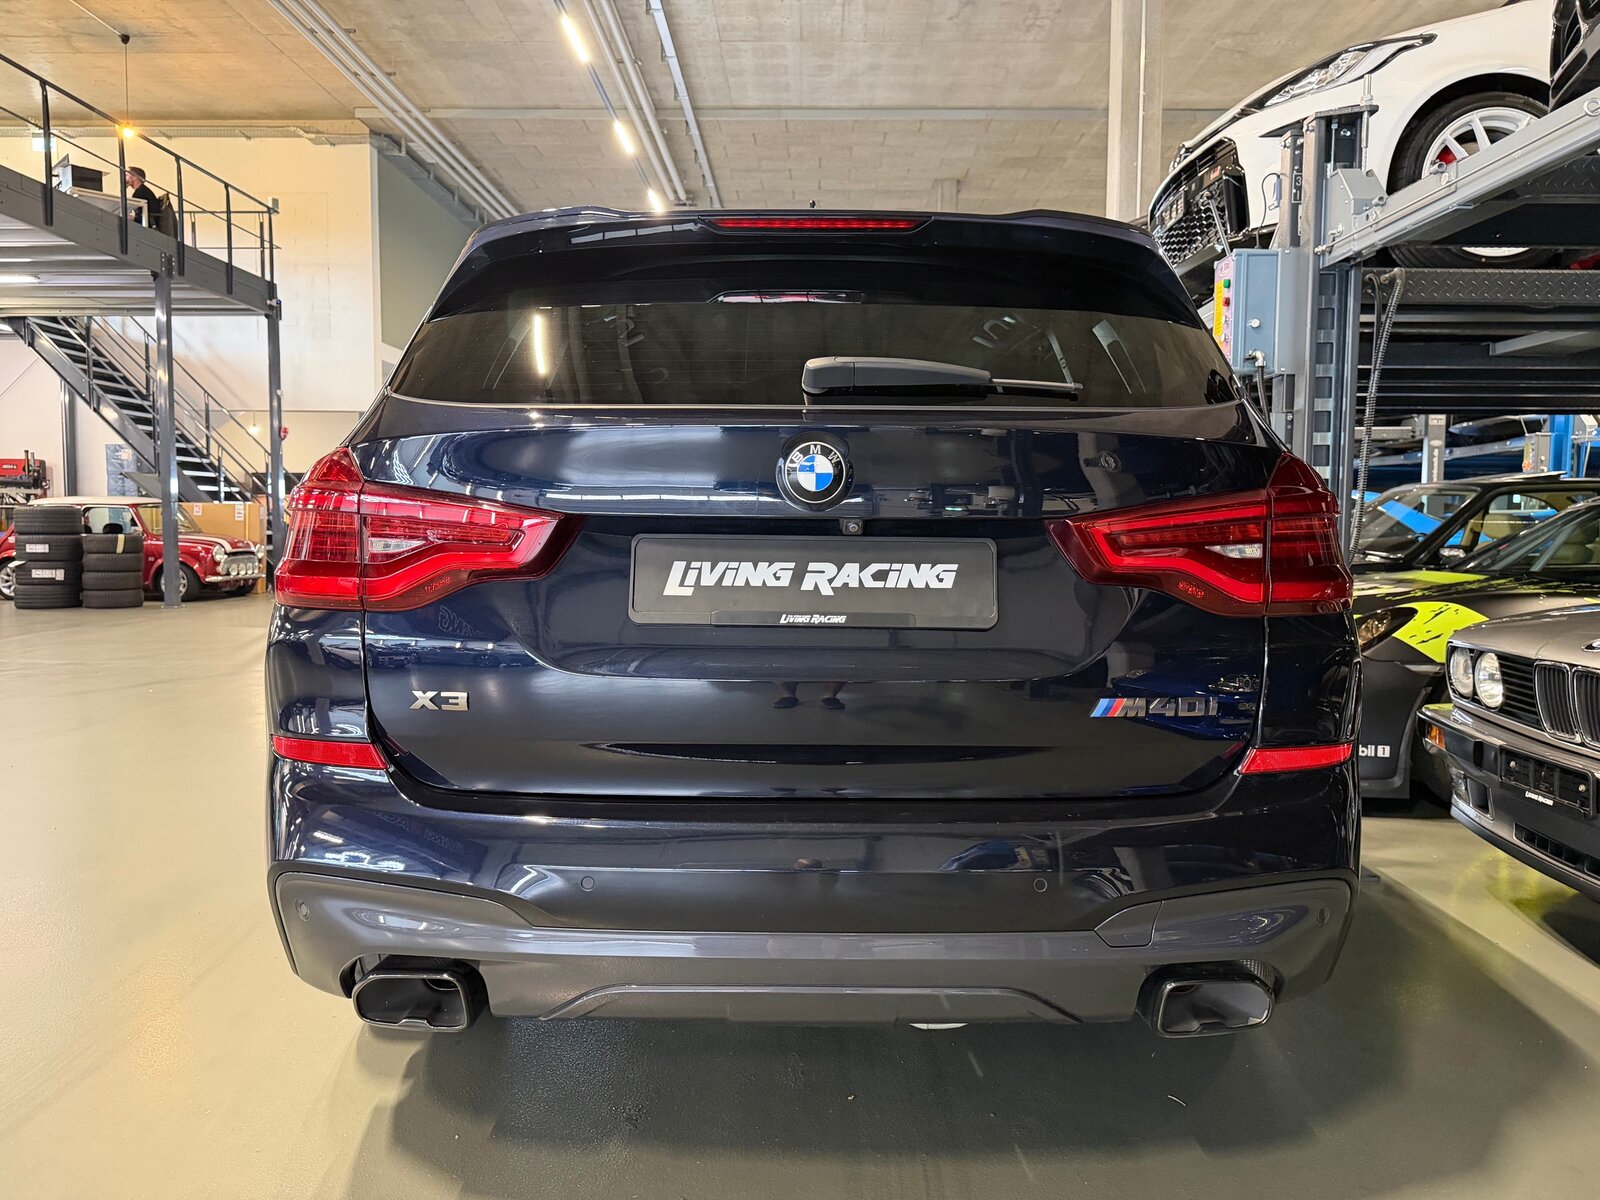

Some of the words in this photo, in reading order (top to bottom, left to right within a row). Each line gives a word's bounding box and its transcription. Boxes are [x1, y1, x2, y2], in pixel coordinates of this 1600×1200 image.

[790, 444, 841, 465] BMW
[409, 690, 469, 711] X3
[1358, 744, 1375, 757] bil
